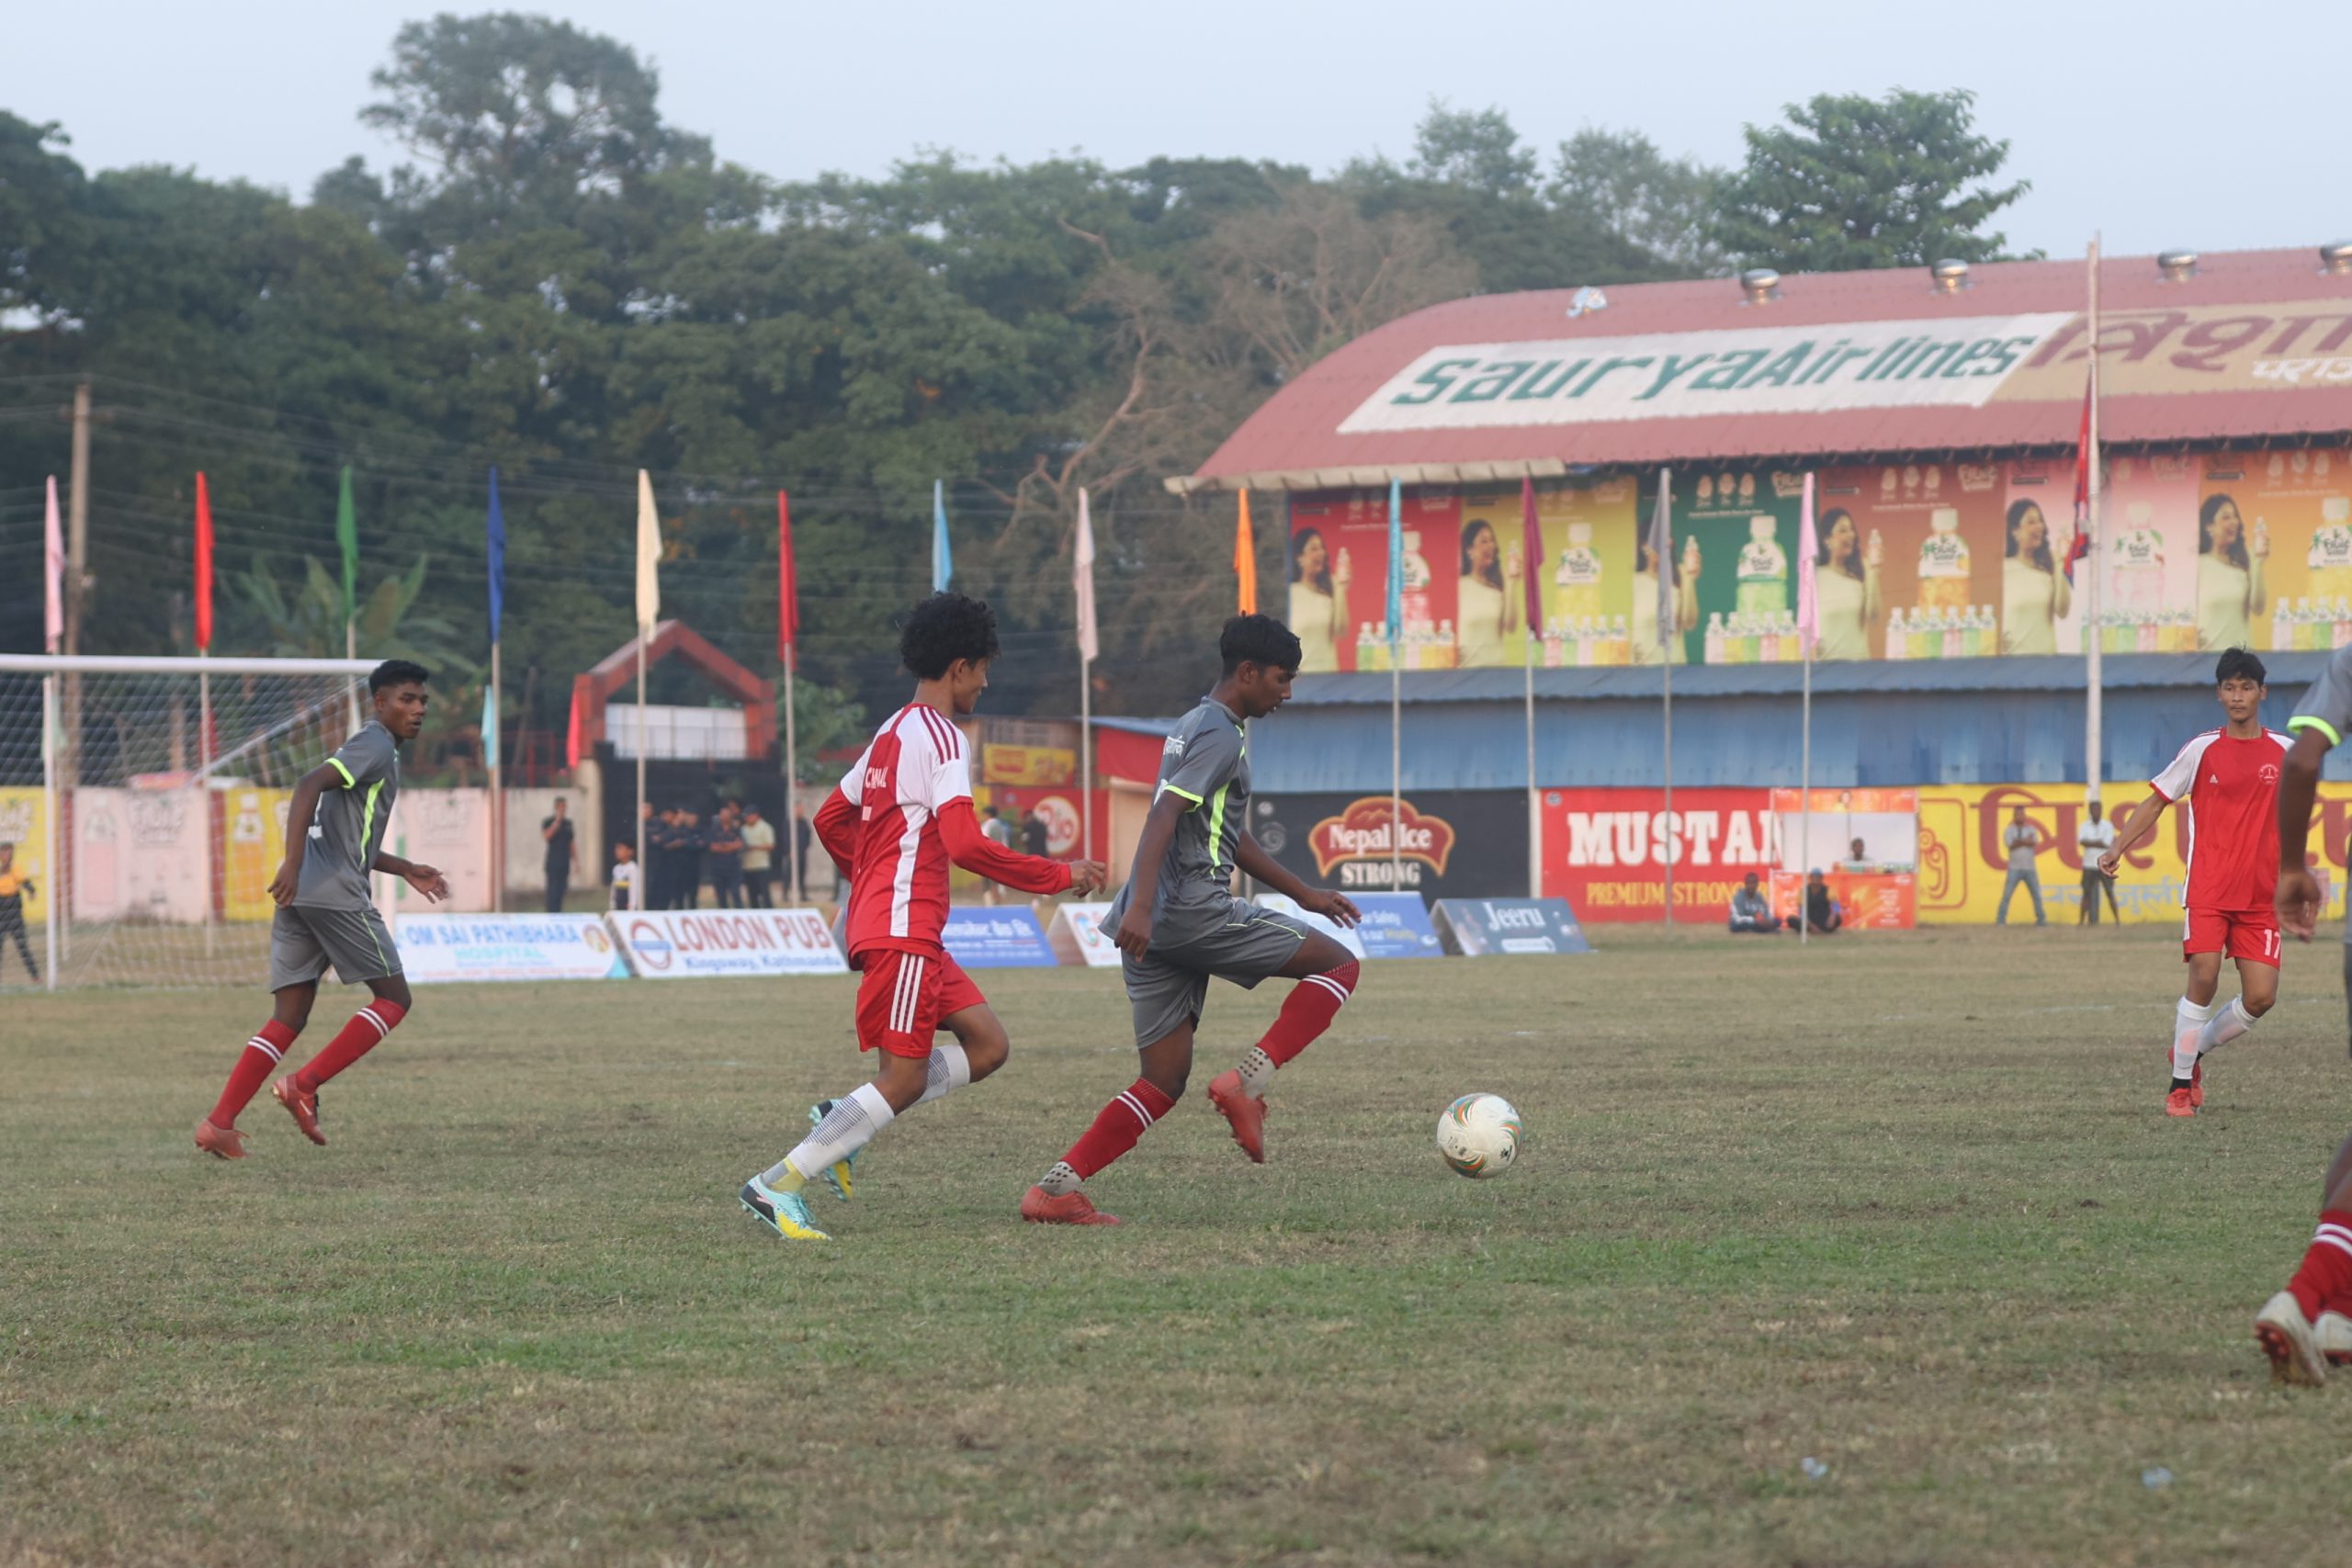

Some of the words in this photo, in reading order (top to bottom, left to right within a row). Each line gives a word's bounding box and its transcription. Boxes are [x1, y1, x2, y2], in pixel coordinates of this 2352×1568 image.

[1329, 823, 1390, 857] Nepal
[1397, 823, 1432, 851] Ice
[1340, 862, 1421, 886] STRONG
[1586, 882, 1667, 906] PREMIUM
[1481, 901, 1546, 931] Jeeru
[406, 924, 435, 945] OM
[437, 924, 469, 944] SAI
[469, 922, 582, 944] PATHIBHARA
[662, 915, 777, 952] LONDON
[773, 915, 832, 949] PUB
[2263, 929, 2281, 960] 17
